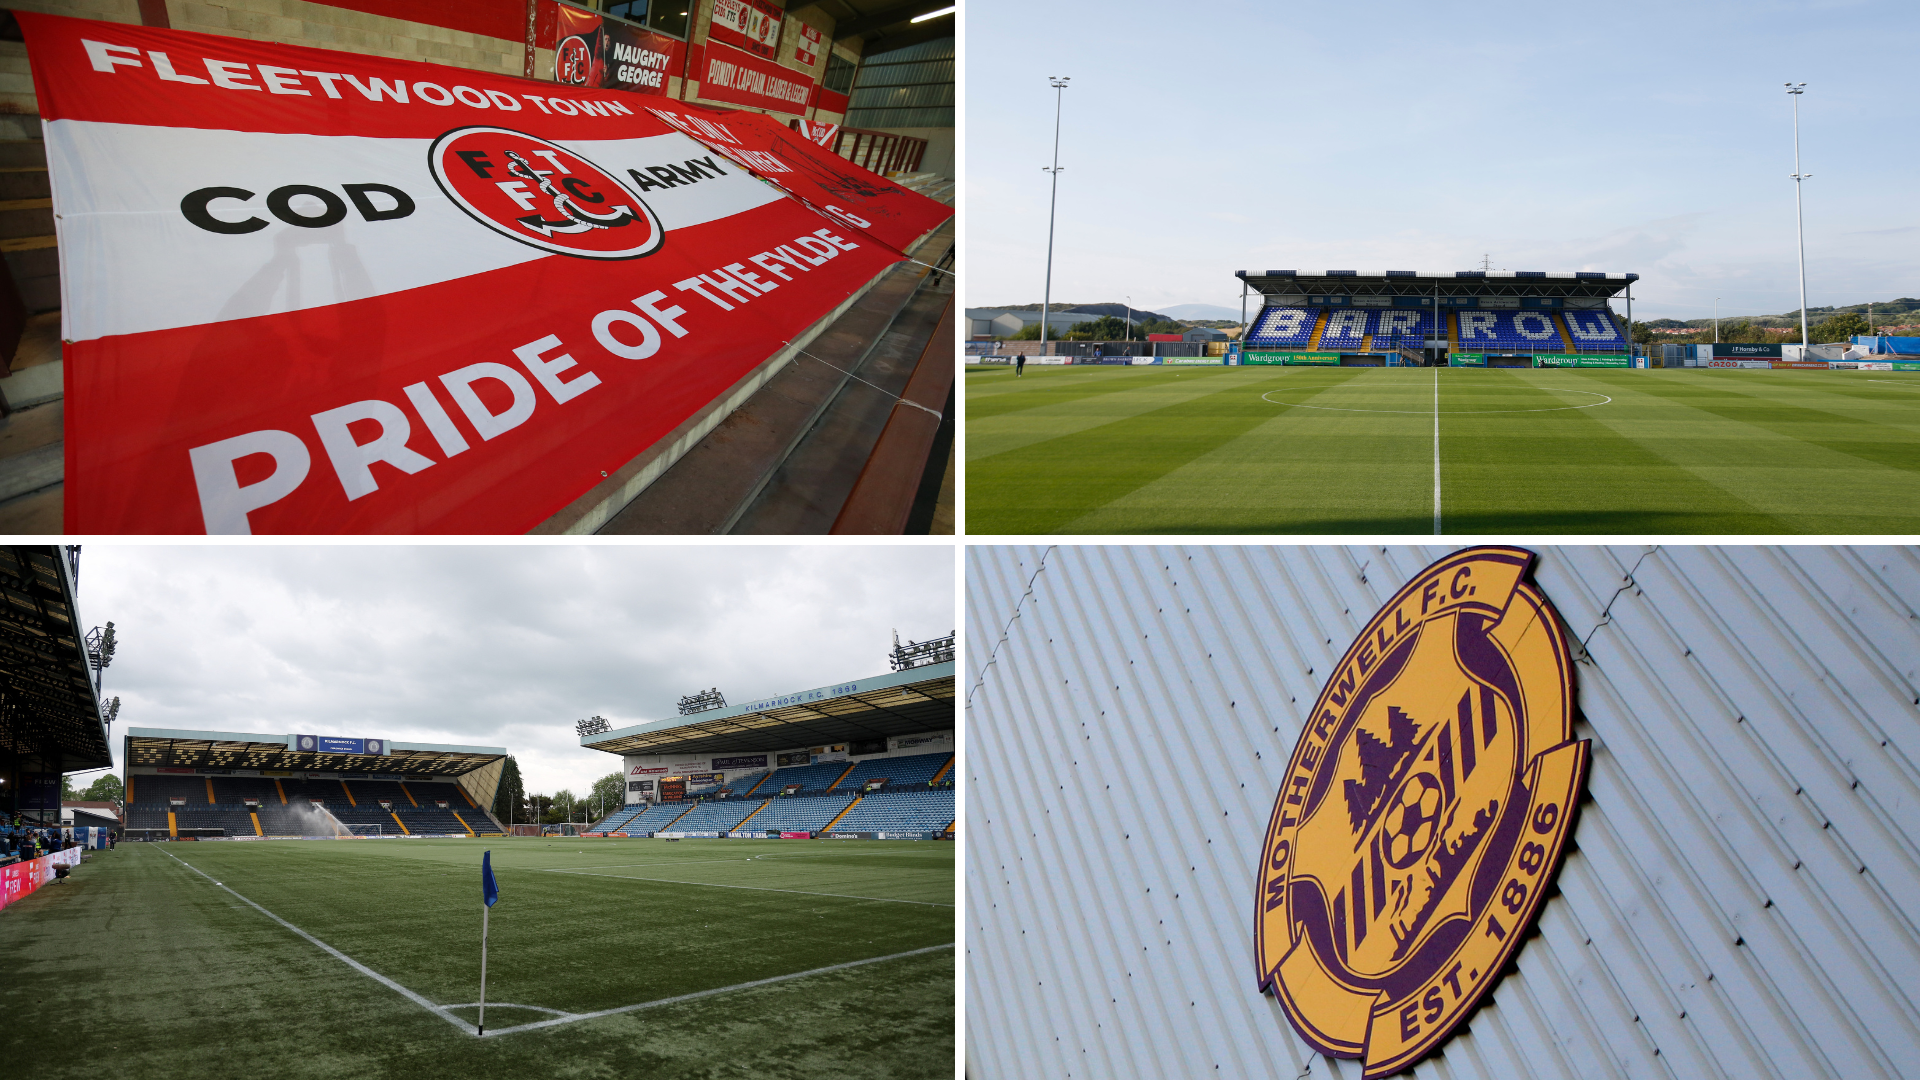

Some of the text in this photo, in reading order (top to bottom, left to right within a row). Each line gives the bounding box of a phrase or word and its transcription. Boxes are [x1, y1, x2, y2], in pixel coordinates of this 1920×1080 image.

[726, 9, 737, 23] FTS
[613, 42, 670, 71] NAUGHTY
[80, 38, 634, 118] FLEETWOOD TOWN
[617, 64, 664, 89] GEORGE
[707, 58, 810, 105] PONDY, CAPTAIN, LEADER & LEGEND
[455, 150, 573, 179] F T
[728, 147, 795, 173] WHEN
[180, 184, 416, 235] COD
[626, 155, 729, 193] ARMY
[494, 176, 606, 212] F C
[1248, 354, 1290, 363] Wardgroup
[1535, 355, 1579, 365] Wardgroup
[188, 226, 861, 536] PRIDE OF THE FYLDE
[745, 695, 803, 712] KILMARNOCK
[832, 684, 858, 695] 1869
[1266, 565, 1476, 913] MOTHERWELL F.C.
[1401, 801, 1559, 1044] EST. 1886
